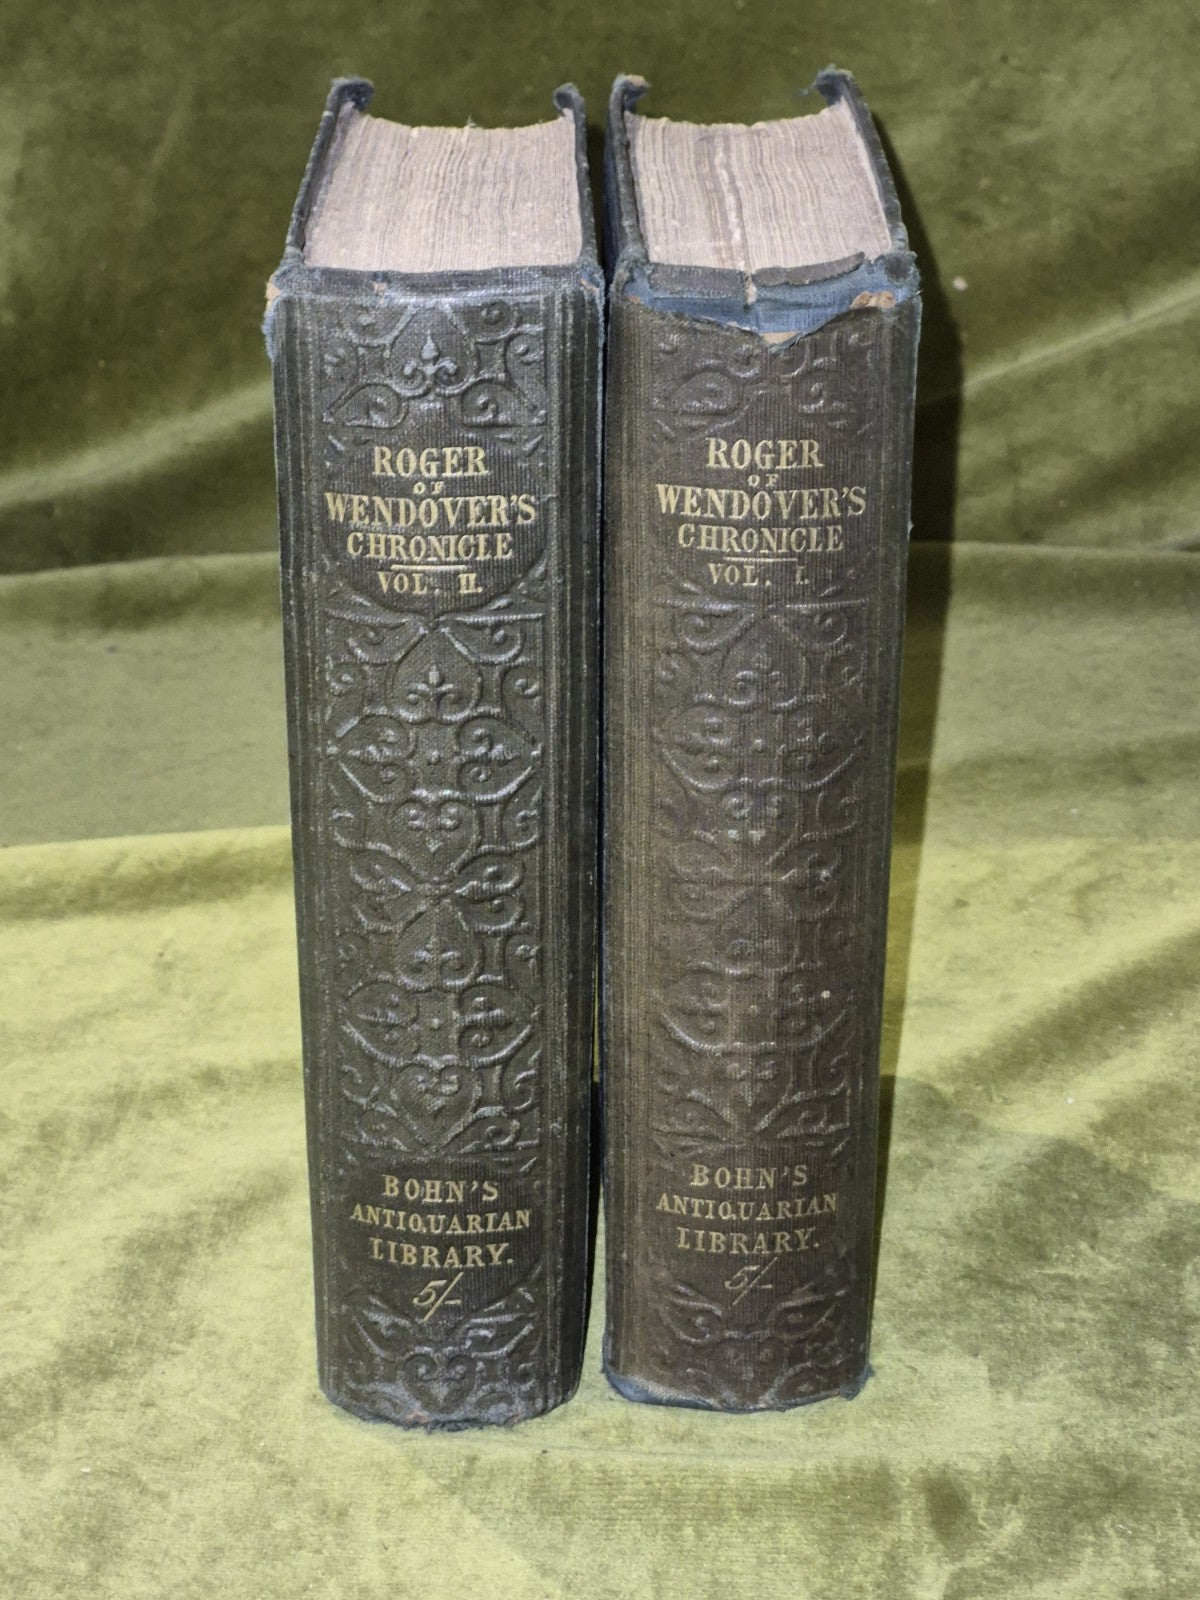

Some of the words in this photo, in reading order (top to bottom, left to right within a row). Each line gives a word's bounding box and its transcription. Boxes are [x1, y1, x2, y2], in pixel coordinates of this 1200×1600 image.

[372, 445, 489, 478] ROGER
[705, 437, 824, 470] ROGER
[413, 481, 445, 495] OF
[748, 474, 779, 488] OF
[324, 492, 538, 528] WENDOVER'S
[656, 483, 867, 520] WENDOVER'S
[347, 532, 514, 561] CHRONICLE
[678, 523, 844, 553] CHRONICLE
[377, 571, 440, 595] VOL.
[707, 563, 772, 586] VOL.
[382, 1174, 499, 1203] BOHN'S
[690, 1164, 808, 1189] BOHN'S
[350, 1203, 532, 1234] ANTIQUARIAN
[656, 1193, 839, 1221] ANTIQUARIAN
[370, 1237, 514, 1269] LIBRARY.
[677, 1227, 820, 1255] LIBRARY.
